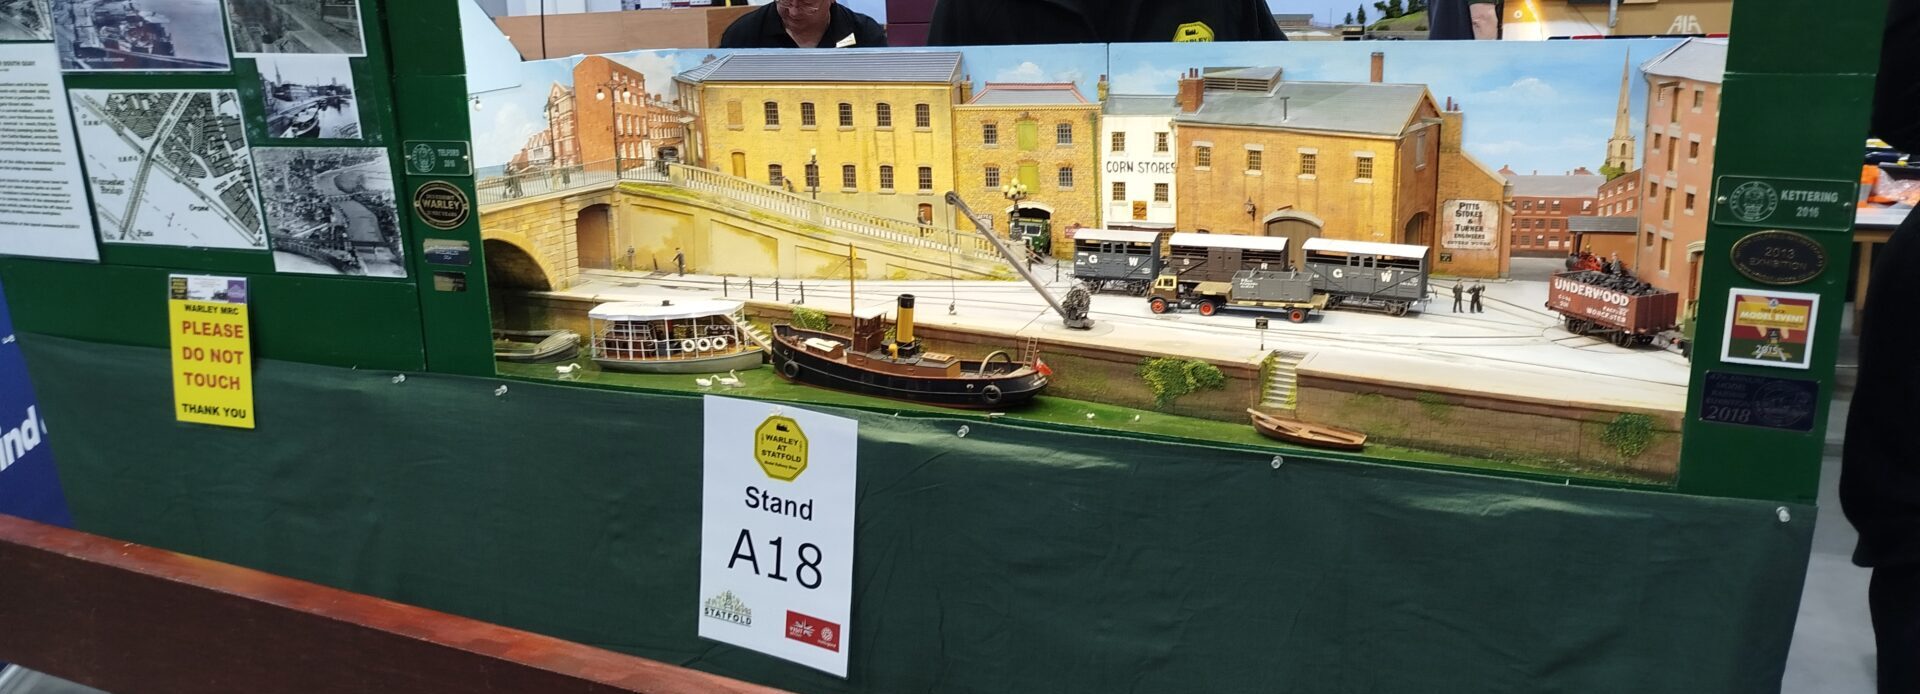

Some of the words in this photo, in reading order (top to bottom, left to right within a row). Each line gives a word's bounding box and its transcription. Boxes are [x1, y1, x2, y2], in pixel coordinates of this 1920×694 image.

[1106, 160, 1134, 174] CORN
[1138, 161, 1176, 174] STORES
[1781, 189, 1839, 203] KETTERING
[420, 199, 461, 210] WARLEY
[1459, 202, 1480, 210] PITTS
[1455, 224, 1484, 232] TURNER
[1088, 254, 1098, 264] G
[1128, 256, 1139, 267] W
[1260, 262, 1268, 270] R
[1332, 268, 1343, 278] G
[1381, 270, 1392, 282] W
[1554, 278, 1630, 307] UNDERWOOD
[184, 303, 218, 314] WARLEY
[220, 306, 239, 316] MRC
[1740, 310, 1773, 321] MODEL
[1775, 313, 1805, 323] EVENT
[181, 320, 244, 339] PLEASE
[182, 346, 204, 361] DO
[210, 348, 244, 365] NOT
[183, 371, 241, 391] TOUCH
[181, 403, 220, 417] THANK
[223, 407, 247, 419] YOU
[1705, 405, 1751, 423] 2018
[765, 434, 799, 446] WARLEY
[776, 444, 787, 452] AT
[761, 449, 802, 463] STATFOLD
[745, 486, 814, 521] Stand
[727, 528, 823, 590] A18
[704, 606, 752, 626] STATFOLD
